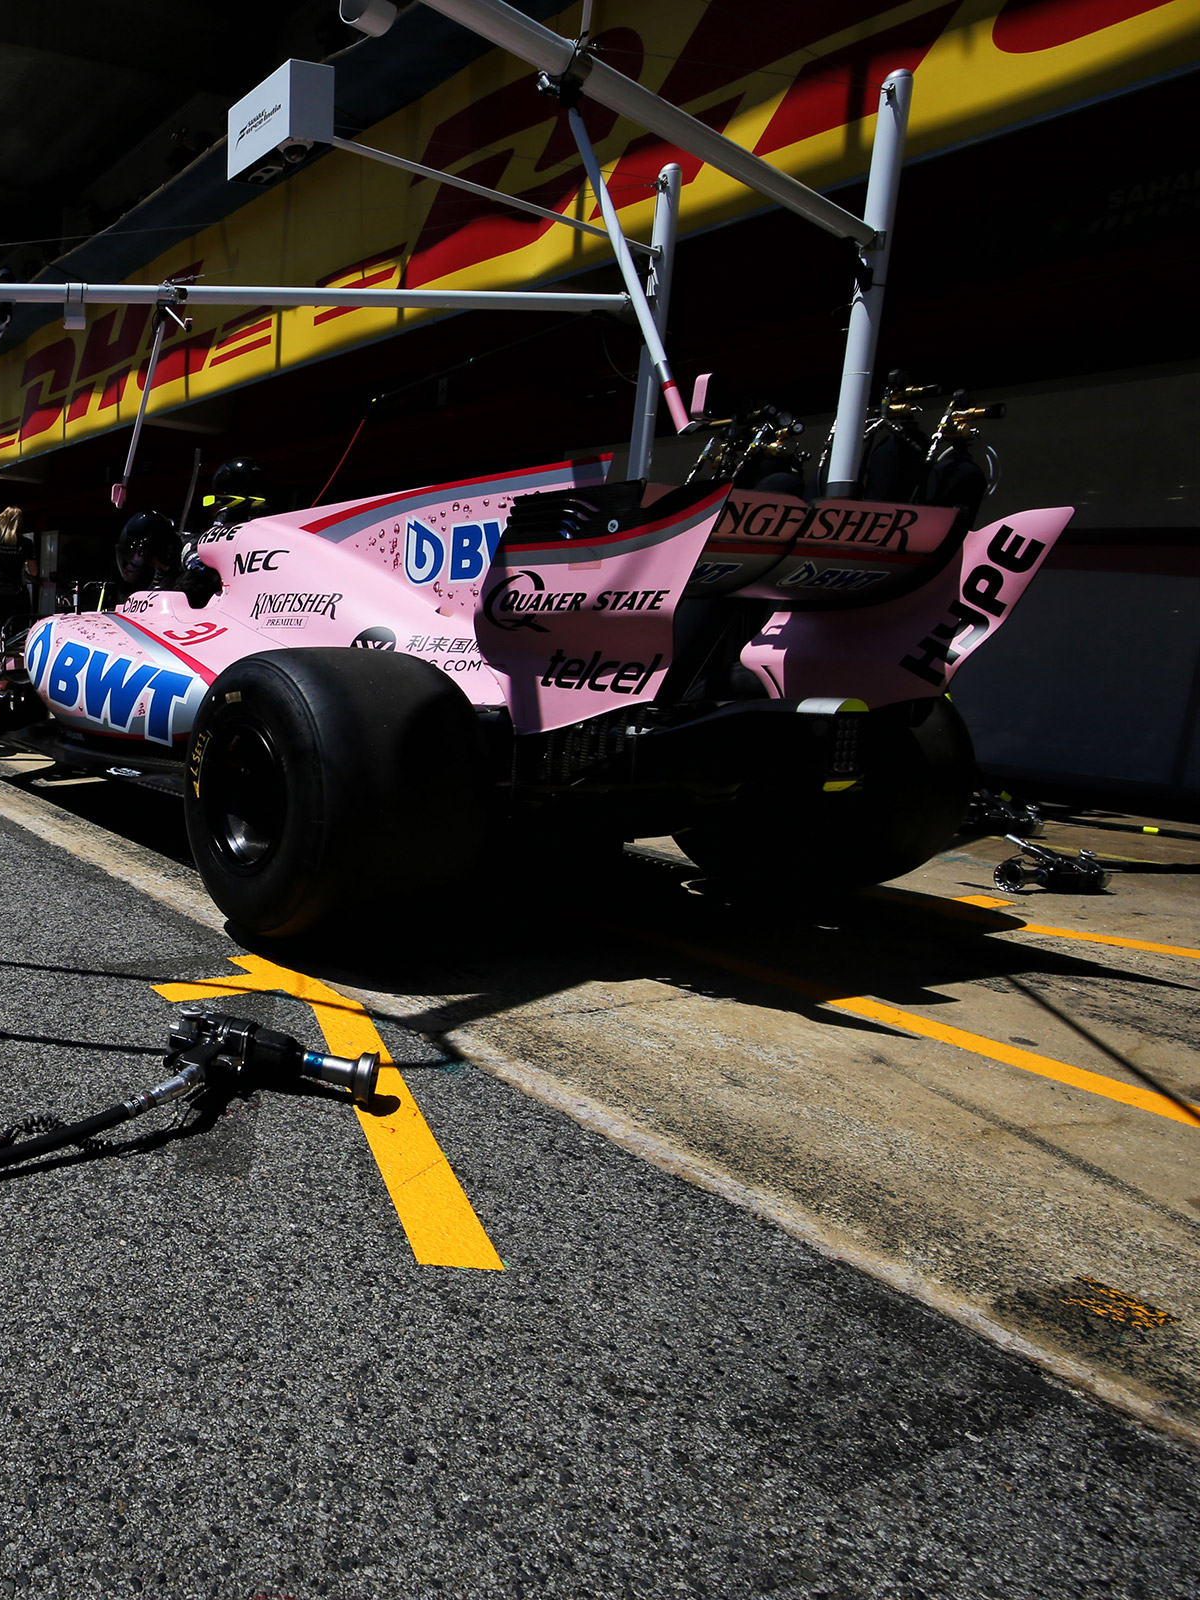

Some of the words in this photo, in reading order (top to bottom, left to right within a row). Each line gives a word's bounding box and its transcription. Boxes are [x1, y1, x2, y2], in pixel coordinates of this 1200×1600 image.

[18, 259, 217, 443] DHL
[714, 500, 919, 553] NGFISHER
[233, 550, 290, 577] NEC
[812, 567, 891, 591] BWT
[122, 597, 149, 613] Claro
[250, 592, 344, 620] KINGFISHER
[499, 590, 587, 612] QUAKER
[591, 589, 671, 611] STATE
[900, 524, 1046, 687] HYPE
[266, 618, 304, 627] PREMIUM
[541, 649, 663, 695] telcel
[49, 639, 196, 745] BWT
